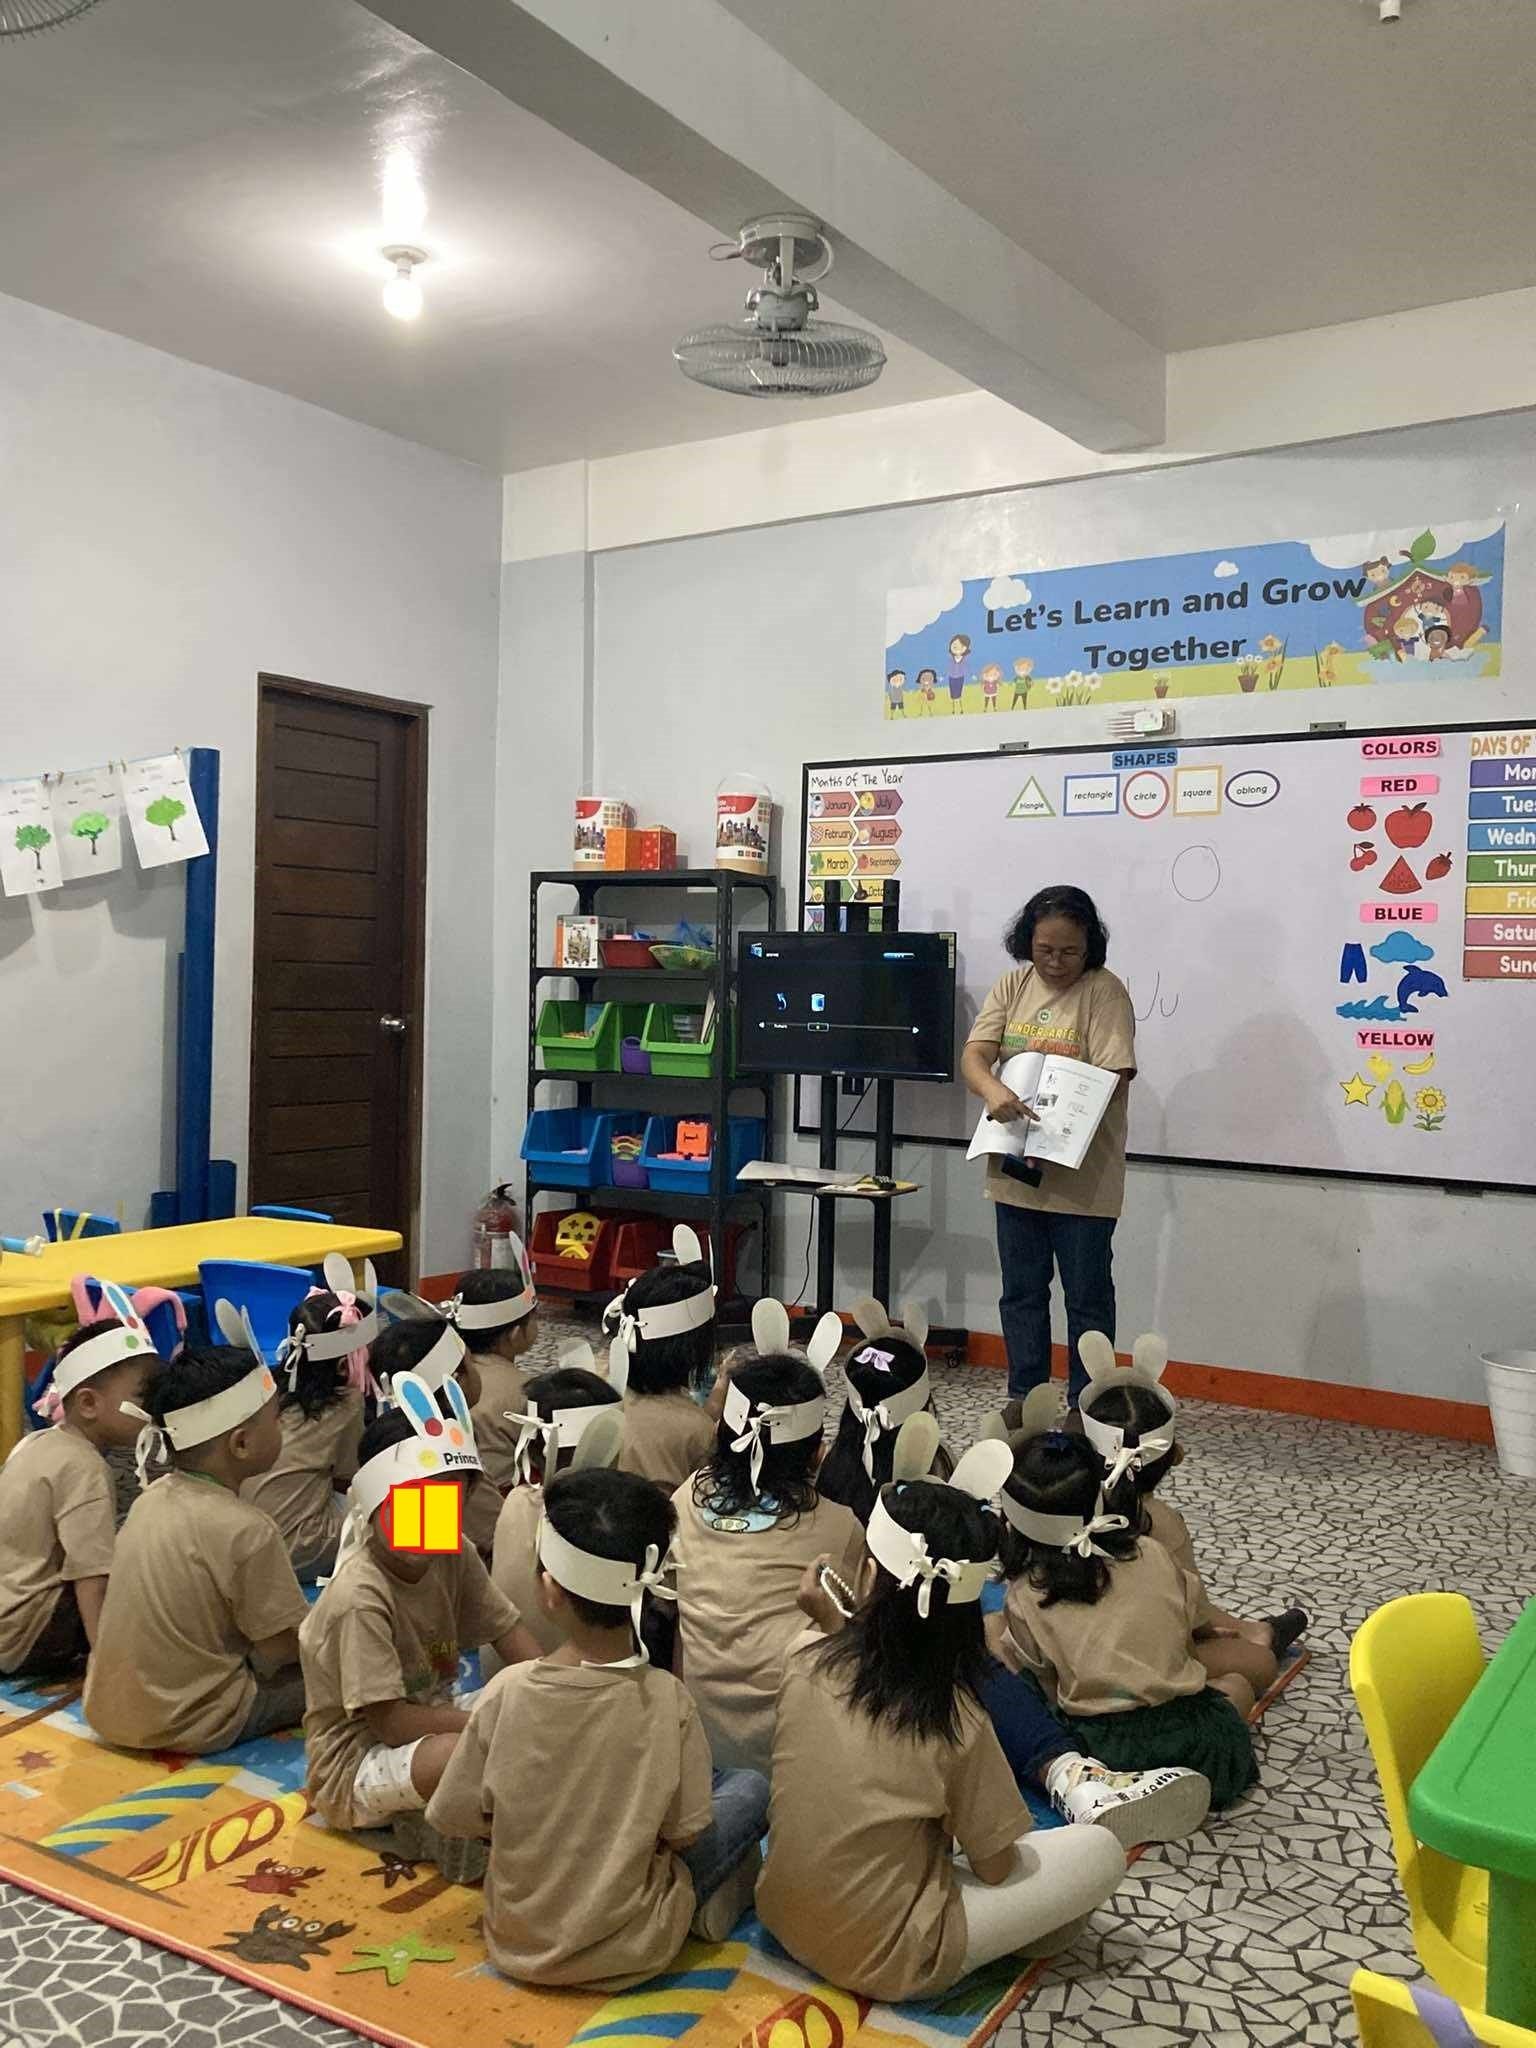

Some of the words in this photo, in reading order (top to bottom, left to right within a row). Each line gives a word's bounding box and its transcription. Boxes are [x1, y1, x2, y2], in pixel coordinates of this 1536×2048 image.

[987, 604, 1063, 634] Let's
[1074, 597, 1170, 625] Learn
[1182, 582, 1249, 613] and
[1262, 577, 1367, 605] Grow
[1084, 636, 1247, 671] Together
[1362, 740, 1437, 756] COLORS
[1471, 735, 1507, 756] DAYS
[1511, 735, 1531, 755] OF
[1114, 751, 1177, 768] SHAPES
[812, 776, 842, 788] Months
[846, 772, 858, 787] Of
[862, 774, 878, 785] The
[882, 768, 903, 785] Year
[1236, 784, 1268, 796] oblong
[1380, 779, 1418, 792] RED
[1073, 790, 1113, 801] rectangle
[1133, 791, 1157, 801] circle
[1182, 788, 1212, 799] square
[825, 800, 852, 811] January
[876, 794, 893, 810] July
[1019, 801, 1044, 810] triangle
[1502, 795, 1536, 814] Tue
[824, 828, 852, 840] February
[870, 827, 898, 841] August
[826, 858, 849, 870] March
[868, 886, 885, 897] Octo
[1374, 908, 1423, 920] BLUE
[1493, 923, 1536, 941] Satu
[1358, 1032, 1434, 1046] YELLOW
